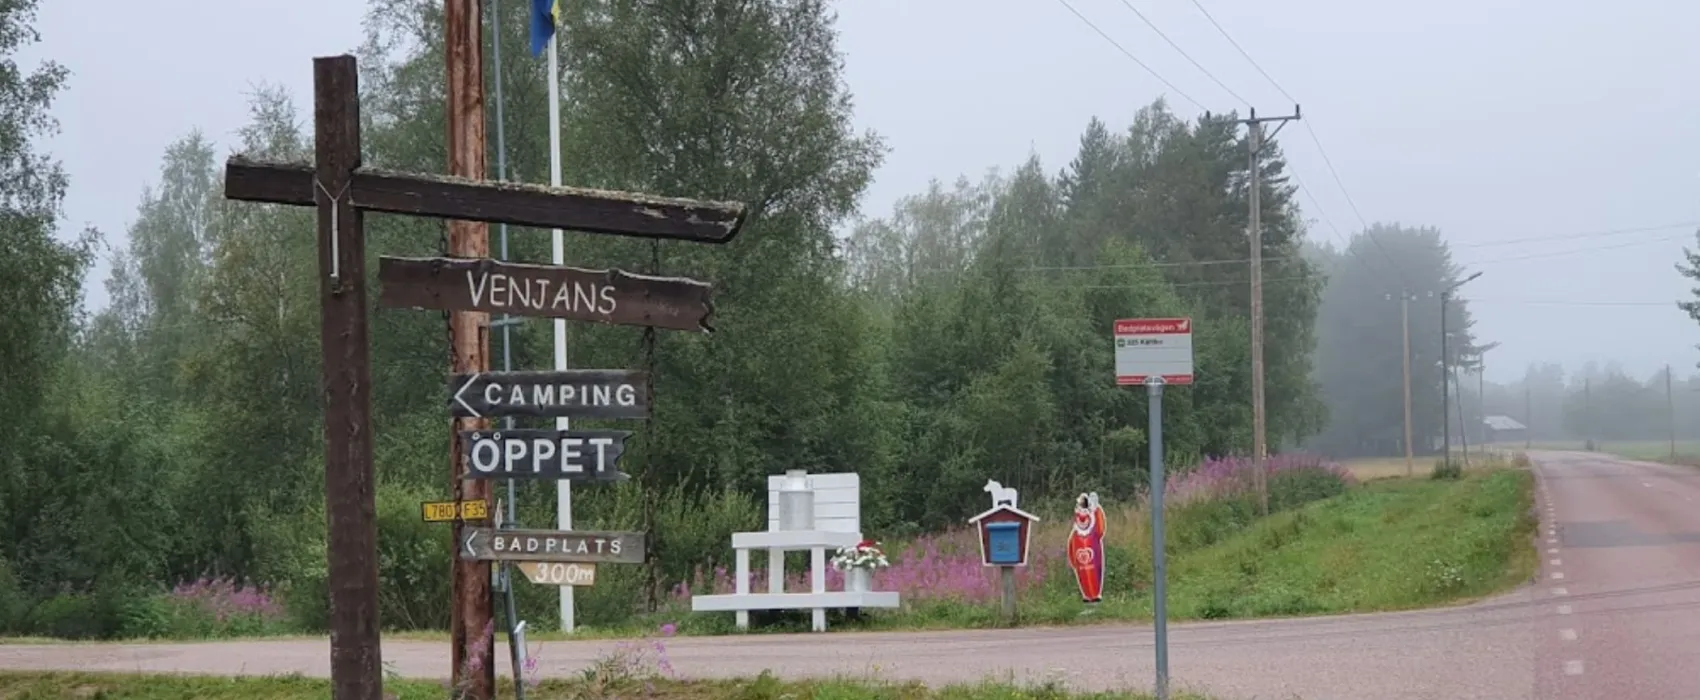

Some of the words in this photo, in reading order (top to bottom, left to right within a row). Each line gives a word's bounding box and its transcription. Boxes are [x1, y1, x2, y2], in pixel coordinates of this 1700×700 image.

[466, 269, 617, 315] VENJANS
[484, 383, 636, 406] CAMPING
[471, 431, 613, 473] ÖPPET
[494, 536, 622, 555] BADPLATS
[534, 562, 594, 583] 300m
